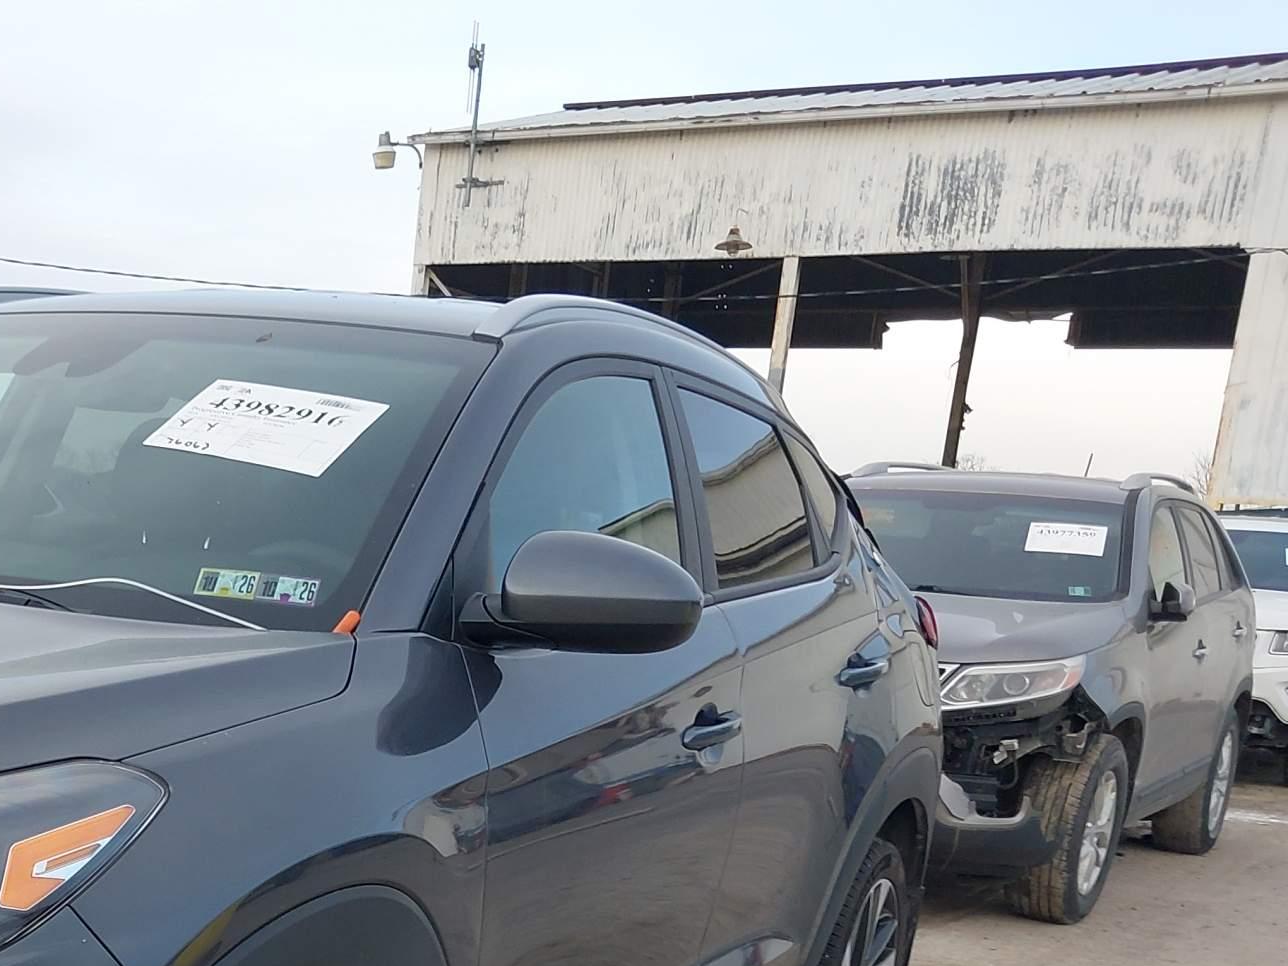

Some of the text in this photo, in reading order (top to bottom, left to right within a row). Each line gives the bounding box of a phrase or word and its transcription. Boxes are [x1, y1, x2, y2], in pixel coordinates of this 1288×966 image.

[209, 396, 348, 428] 43982916
[238, 575, 256, 594] 26
[299, 581, 317, 601] 26
